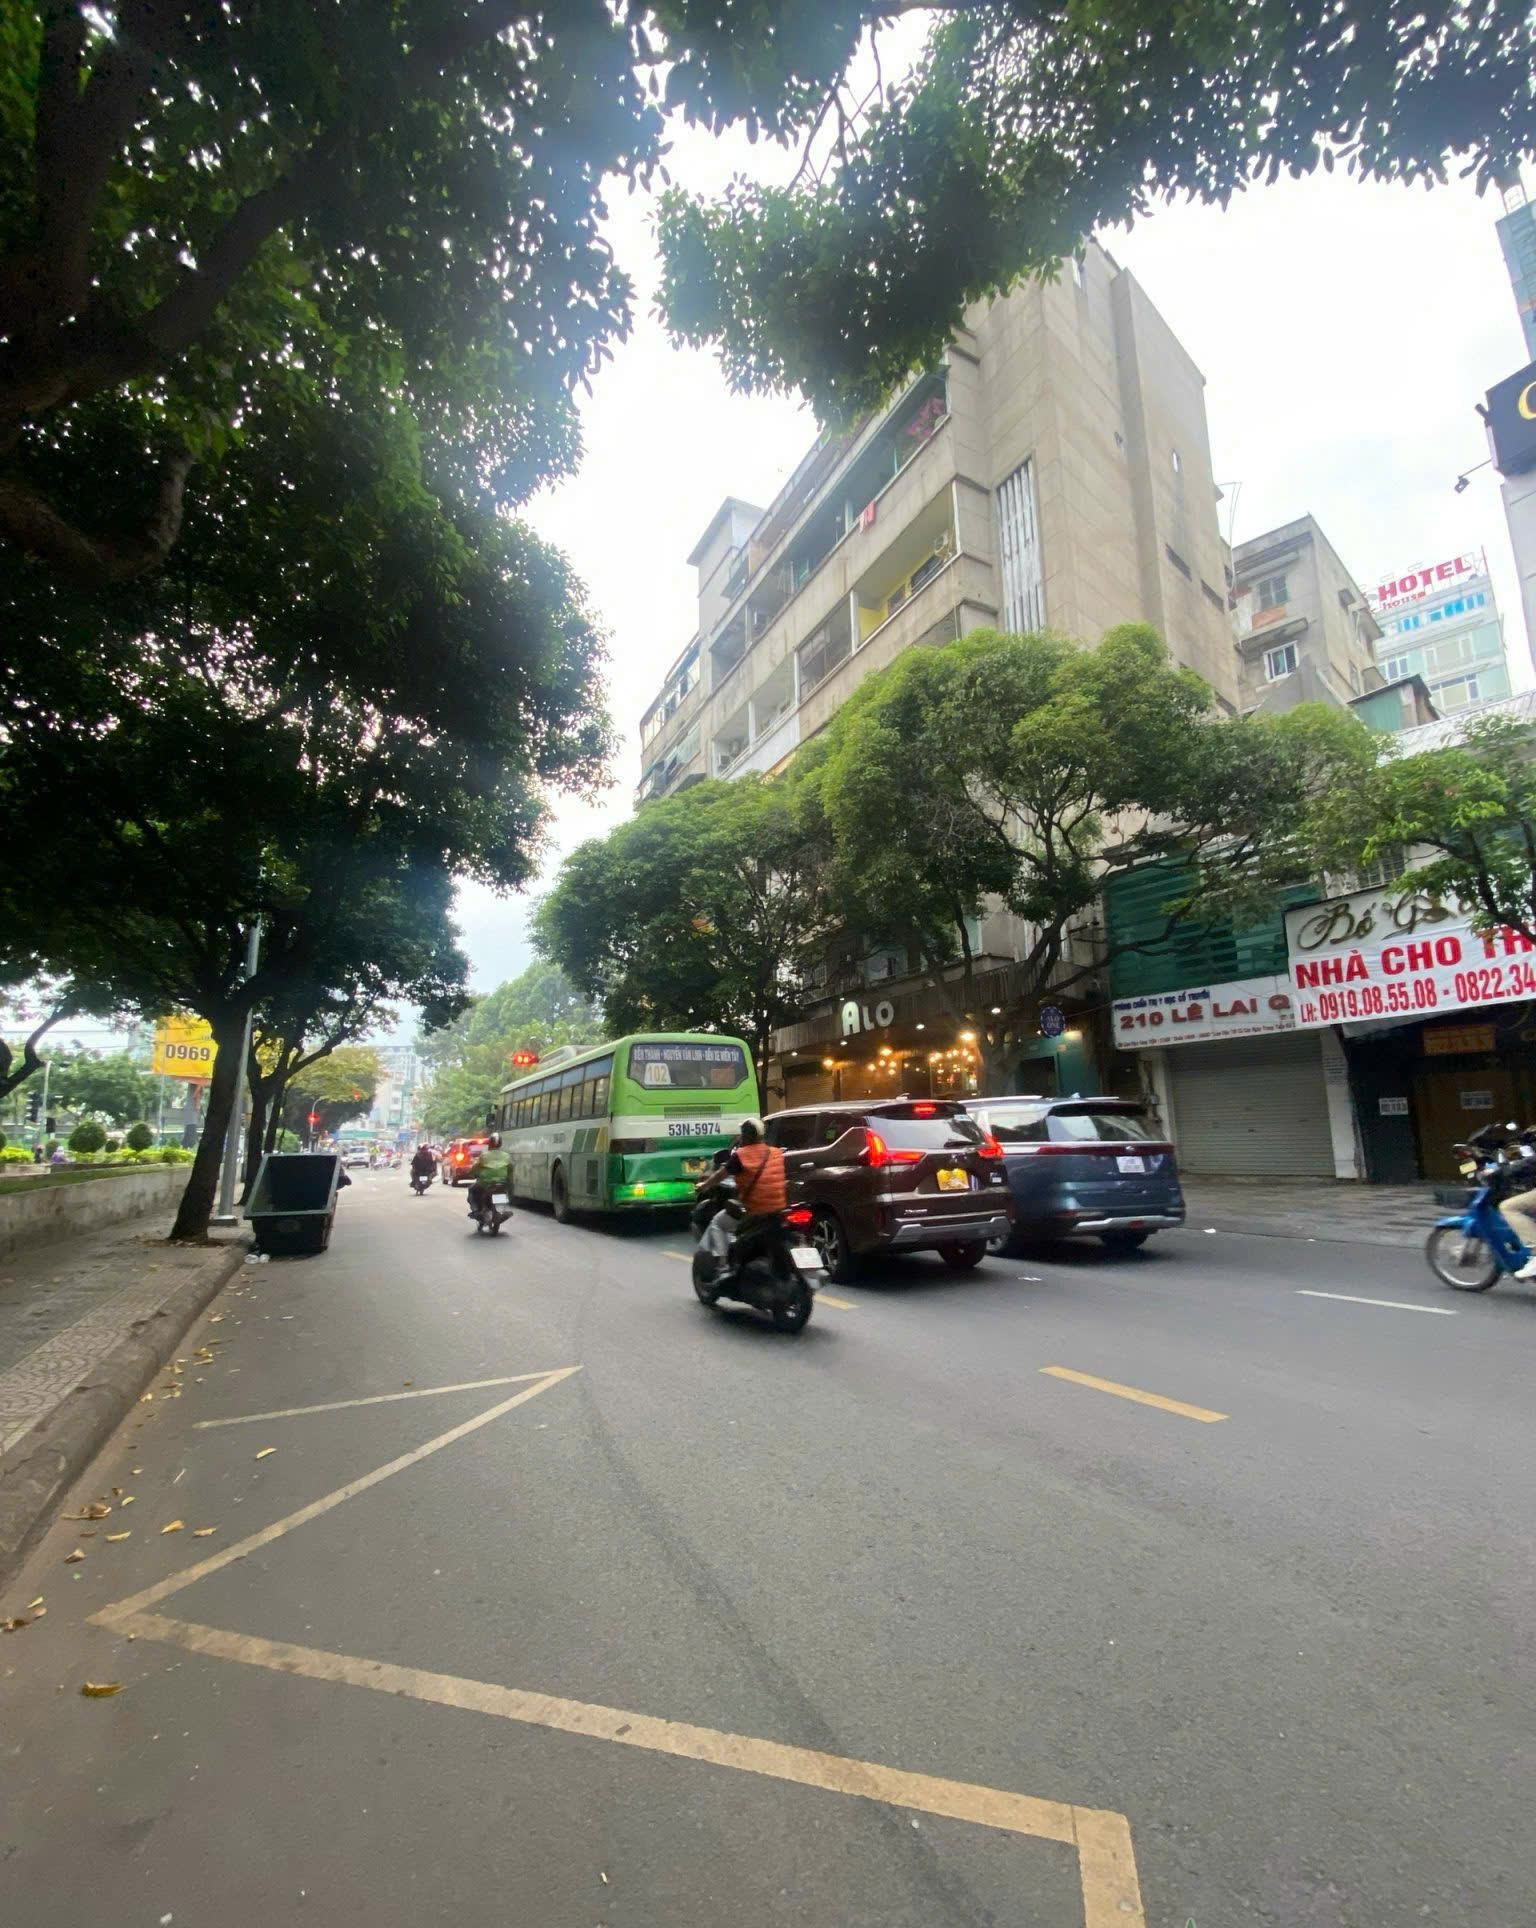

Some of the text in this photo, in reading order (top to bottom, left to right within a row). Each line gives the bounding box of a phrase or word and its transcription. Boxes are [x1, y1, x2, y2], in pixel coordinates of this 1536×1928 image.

[1378, 557, 1471, 600] HOTEL
[1295, 950, 1369, 989] NHÀ
[1381, 936, 1462, 976] CHO
[1301, 962, 1536, 1023] LH: 0919.08.55.08 0822.34
[842, 1001, 895, 1036] ALO
[1120, 1011, 1165, 1030] 210
[1171, 1003, 1204, 1023] LÊ
[1212, 998, 1258, 1018] LAI
[165, 1044, 210, 1061] 0969
[647, 1065, 667, 1082] 102
[668, 1123, 721, 1136] 53N-5974
